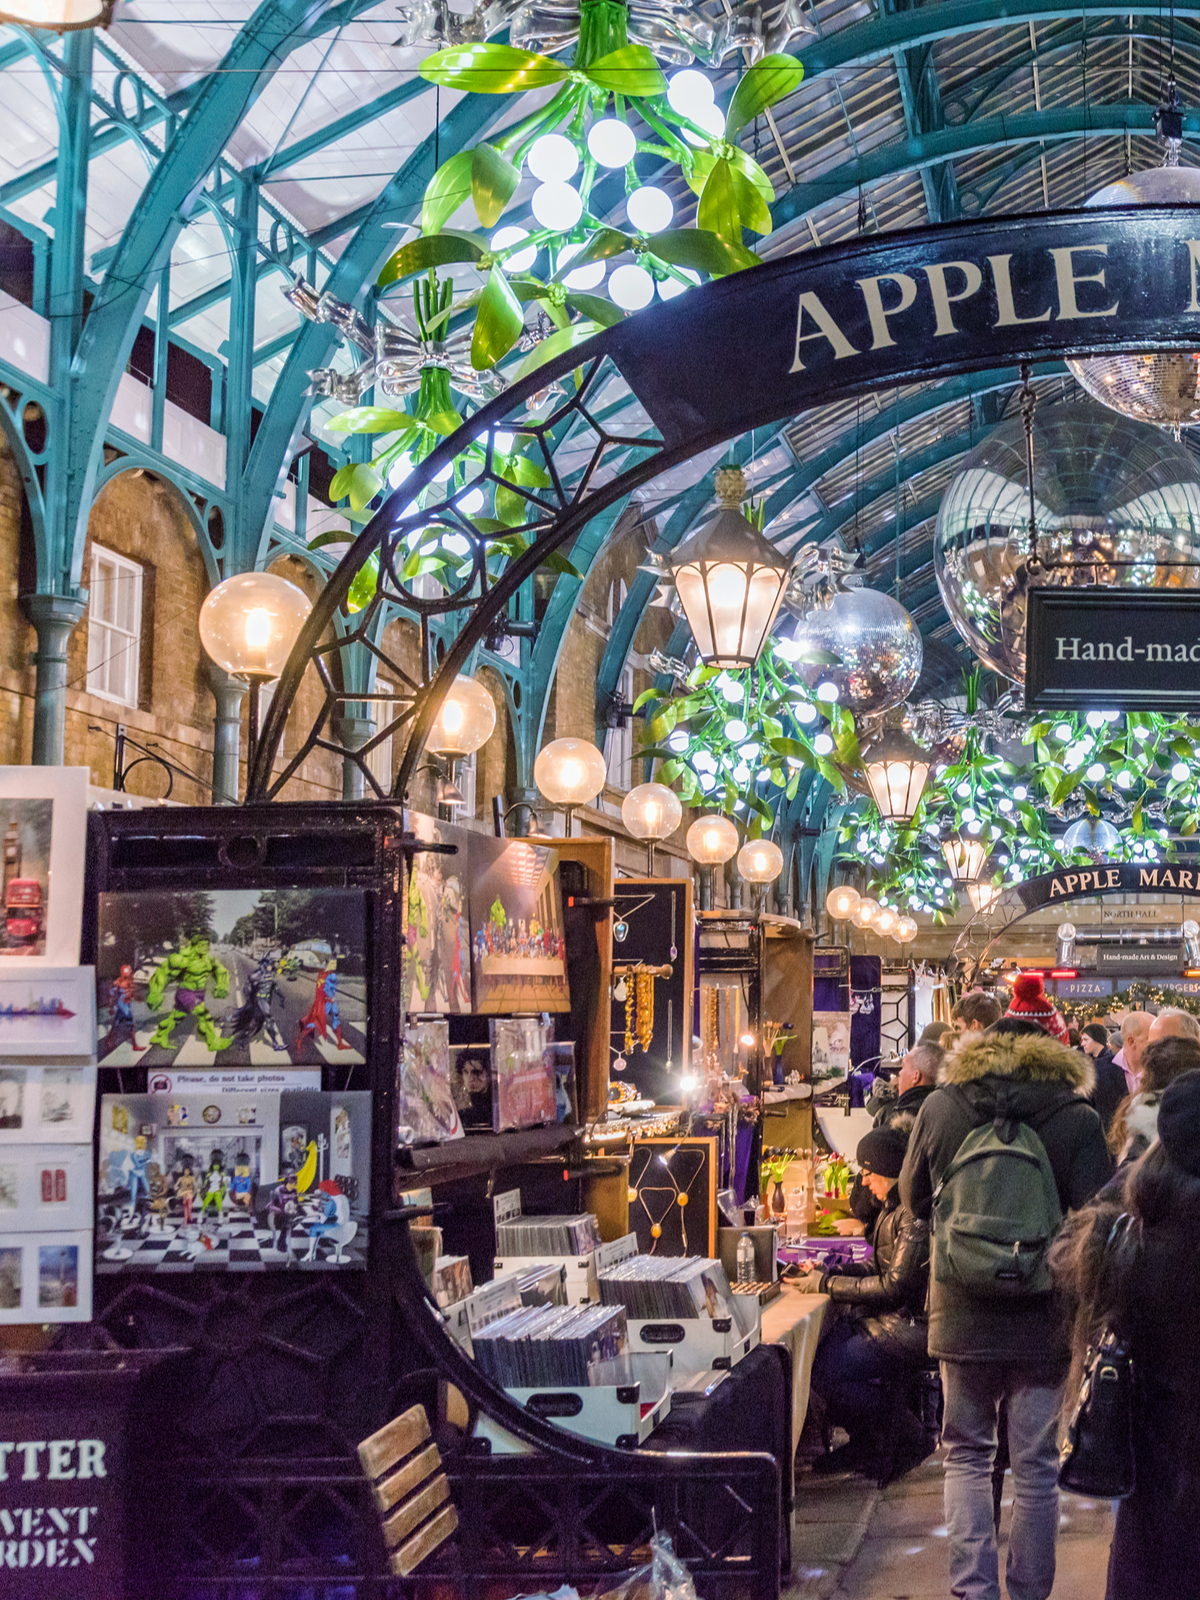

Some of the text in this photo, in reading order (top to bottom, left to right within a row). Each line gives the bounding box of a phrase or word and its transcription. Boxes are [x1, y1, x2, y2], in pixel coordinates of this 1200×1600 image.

[787, 243, 1121, 374] APPLE
[1049, 869, 1122, 898] APPLE
[1103, 910, 1134, 919] NORTH
[1103, 953, 1139, 961] Hand-made
[1139, 953, 1150, 961] Art
[1156, 953, 1178, 962] Design
[1069, 984, 1101, 993] PIZZA
[208, 1075, 219, 1083] do
[221, 1075, 235, 1083] not
[237, 1074, 255, 1083] take
[257, 1075, 286, 1084] photos
